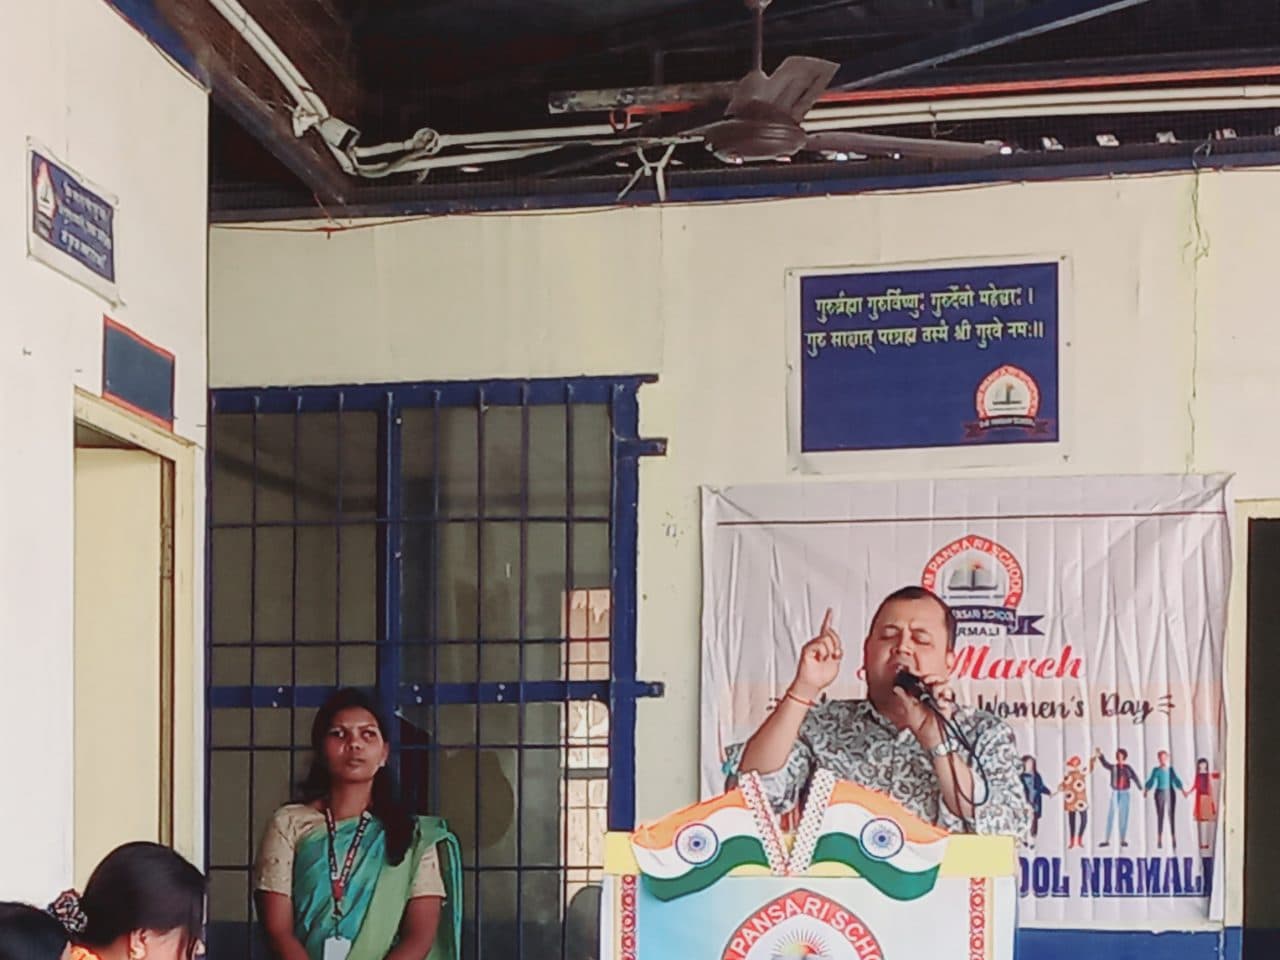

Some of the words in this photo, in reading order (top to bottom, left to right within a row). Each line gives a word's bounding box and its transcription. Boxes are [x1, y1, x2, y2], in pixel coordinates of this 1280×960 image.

[959, 626, 1000, 637] RMALI
[949, 645, 1082, 680] March
[730, 896, 830, 956] PANSARI
